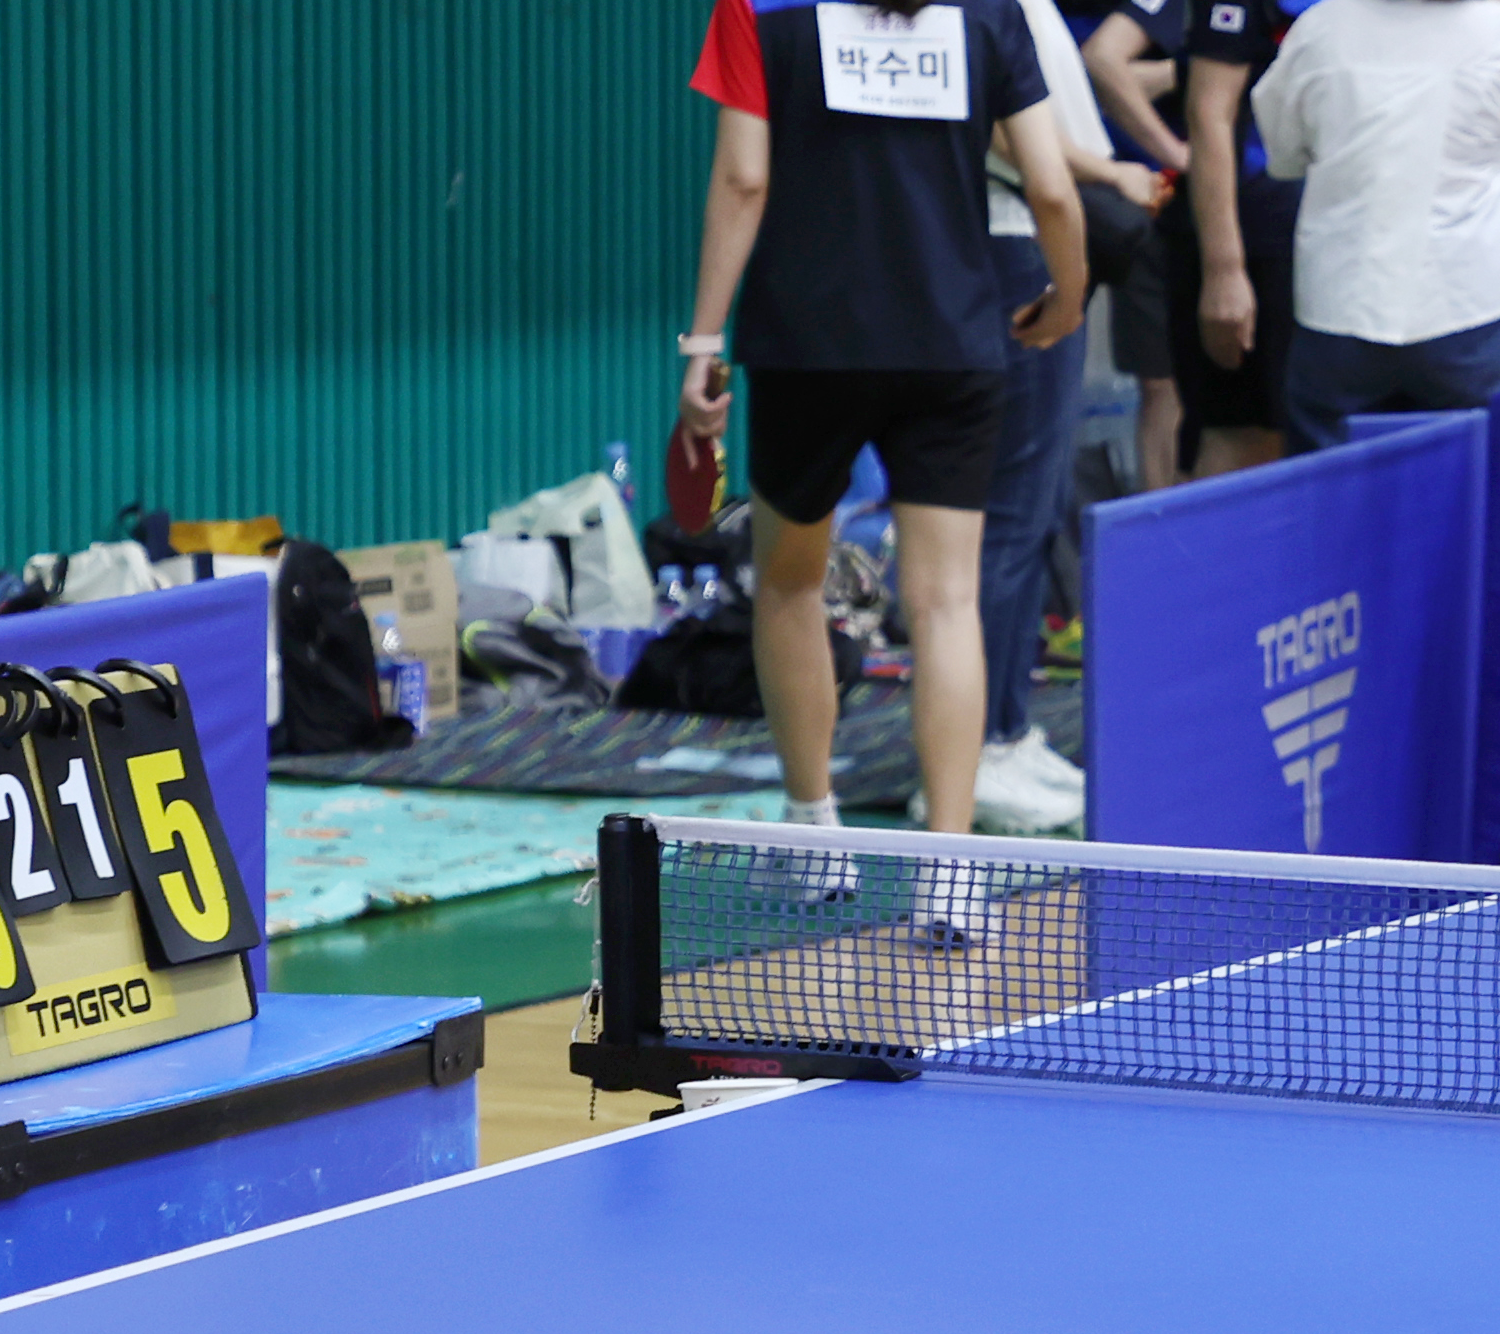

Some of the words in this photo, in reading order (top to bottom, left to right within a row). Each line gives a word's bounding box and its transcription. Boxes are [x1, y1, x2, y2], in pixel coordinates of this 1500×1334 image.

[836, 45, 949, 90] 박수미
[1254, 589, 1362, 690] TAGRO
[57, 757, 116, 880] 1
[125, 747, 232, 944] 5
[26, 977, 152, 1039] TAGRO
